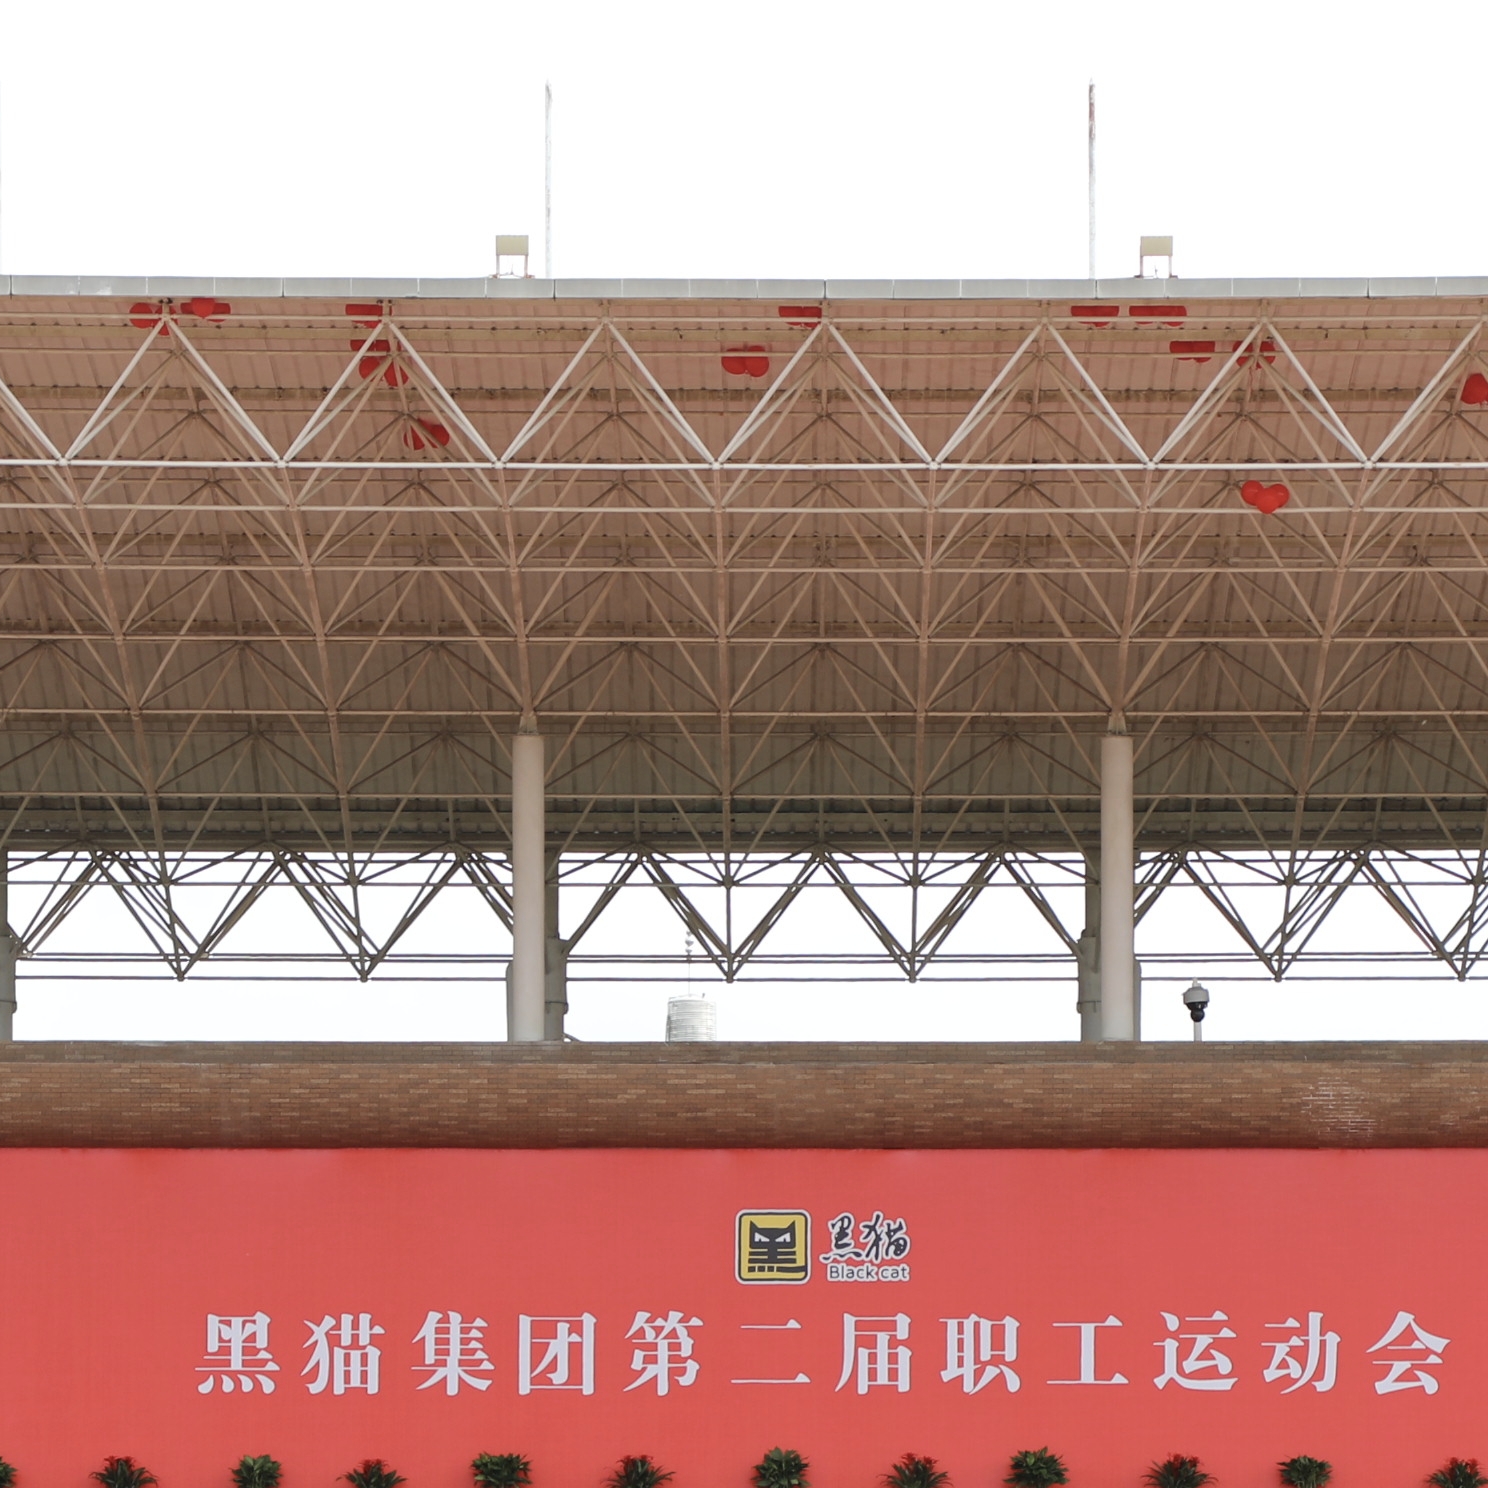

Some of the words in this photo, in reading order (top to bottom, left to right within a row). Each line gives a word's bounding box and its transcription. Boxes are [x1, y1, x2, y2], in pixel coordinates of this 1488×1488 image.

[821, 1213, 909, 1261] 黑猫
[829, 1265, 875, 1280] Black
[880, 1266, 908, 1280] cat
[196, 1310, 1450, 1397] 黑猫集团第二届职工运动会
